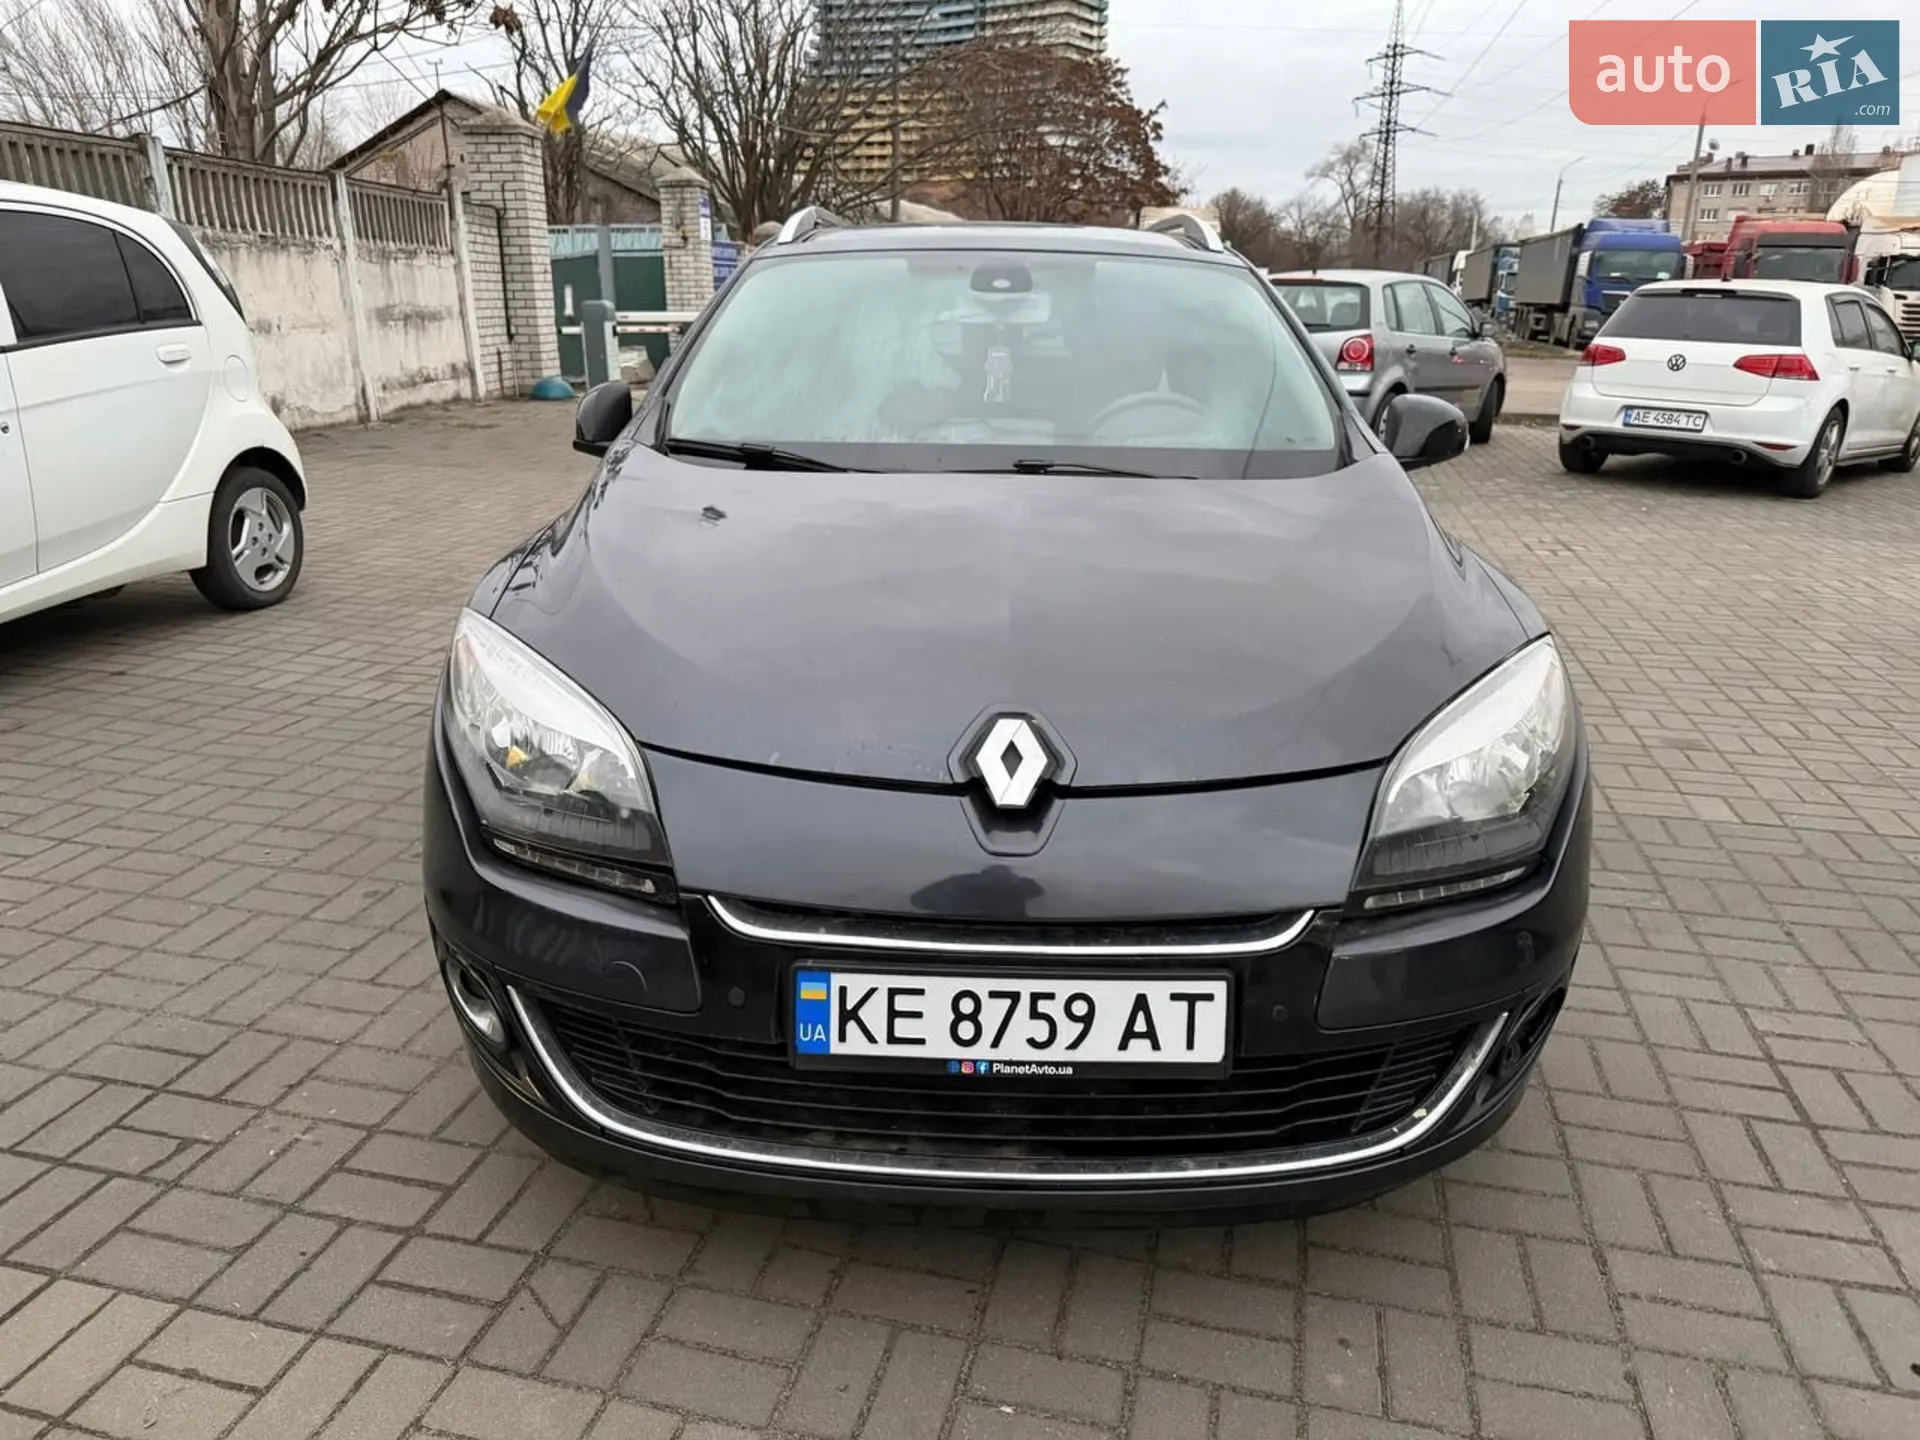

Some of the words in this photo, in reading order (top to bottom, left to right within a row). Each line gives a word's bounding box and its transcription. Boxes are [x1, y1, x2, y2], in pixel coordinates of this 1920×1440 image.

[1632, 410, 1651, 424] AE
[1653, 411, 1681, 426] 4584
[1685, 414, 1703, 427] TC
[838, 985, 927, 1045] KE
[949, 989, 1096, 1050] 8759
[1117, 993, 1215, 1051] AT
[800, 1023, 827, 1042] UA
[992, 1062, 1074, 1076] PlanetAvto.ua
